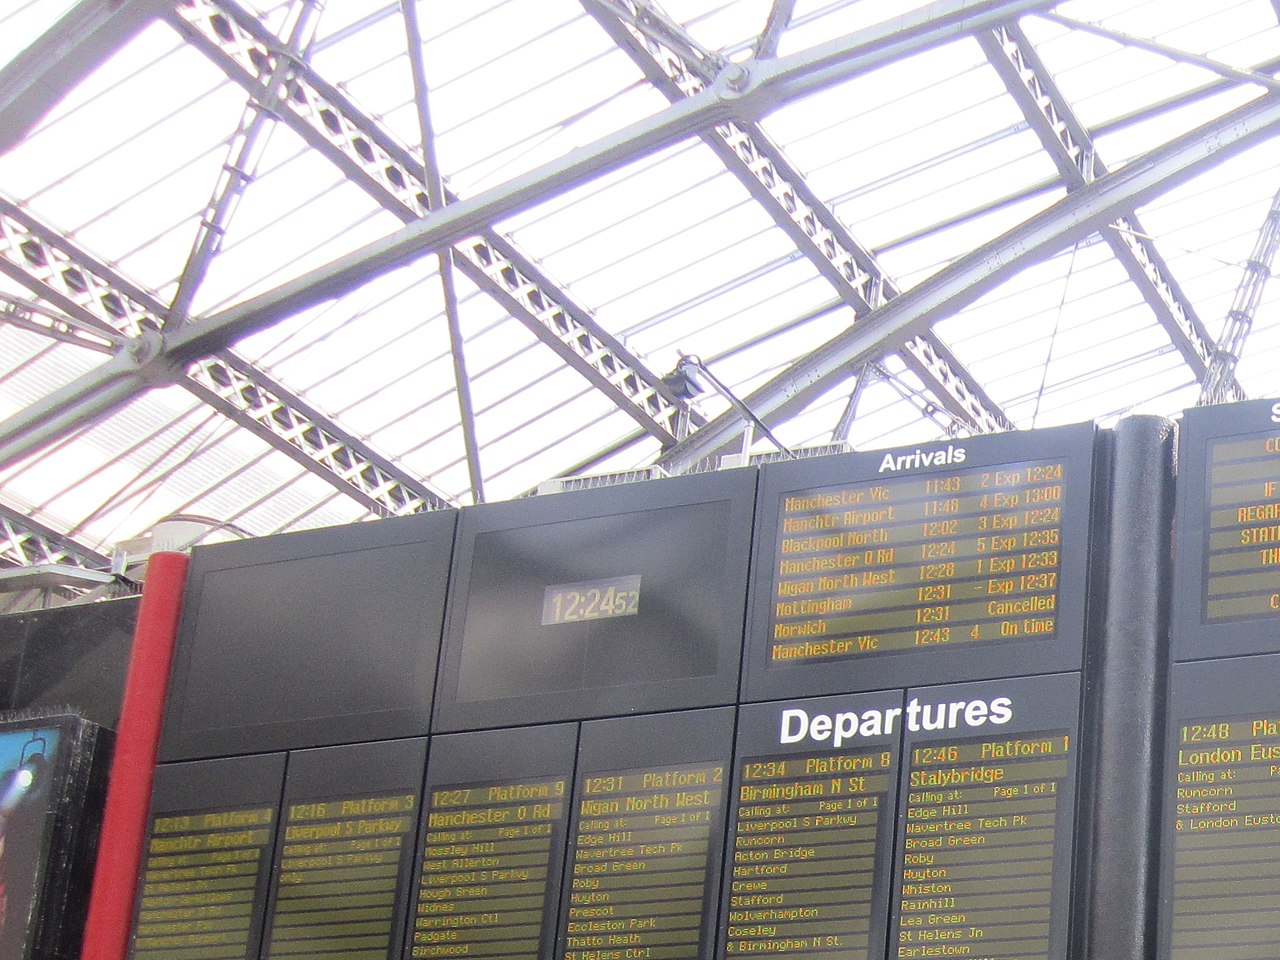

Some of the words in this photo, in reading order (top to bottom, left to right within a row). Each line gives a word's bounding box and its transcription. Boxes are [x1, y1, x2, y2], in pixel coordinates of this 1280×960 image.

[879, 446, 966, 472] Arrivals
[1265, 482, 1276, 496] IF
[774, 621, 826, 638] Norwich
[916, 606, 950, 623] 12:31
[988, 596, 1055, 617] Cancelled
[772, 641, 852, 661] Manchester
[858, 636, 878, 650] Vic
[914, 628, 950, 645] 12:43
[970, 625, 979, 639] 4
[1000, 622, 1018, 636] On
[1024, 618, 1053, 633] time
[780, 697, 1013, 747] Departures
[1180, 723, 1230, 741] 12:48
[913, 746, 958, 763] 12:46
[981, 741, 1053, 759] Platform
[1063, 736, 1069, 751] 1
[1178, 746, 1242, 764] London
[743, 761, 786, 777] 12:34
[806, 755, 874, 773] Platform
[881, 752, 891, 767] 8
[910, 766, 1004, 788] Stalybridge
[584, 776, 623, 793] 12:31
[643, 770, 707, 788] Platform
[713, 767, 723, 782] 2
[581, 800, 619, 816] Wigan
[625, 796, 669, 812] North
[676, 792, 710, 807] West
